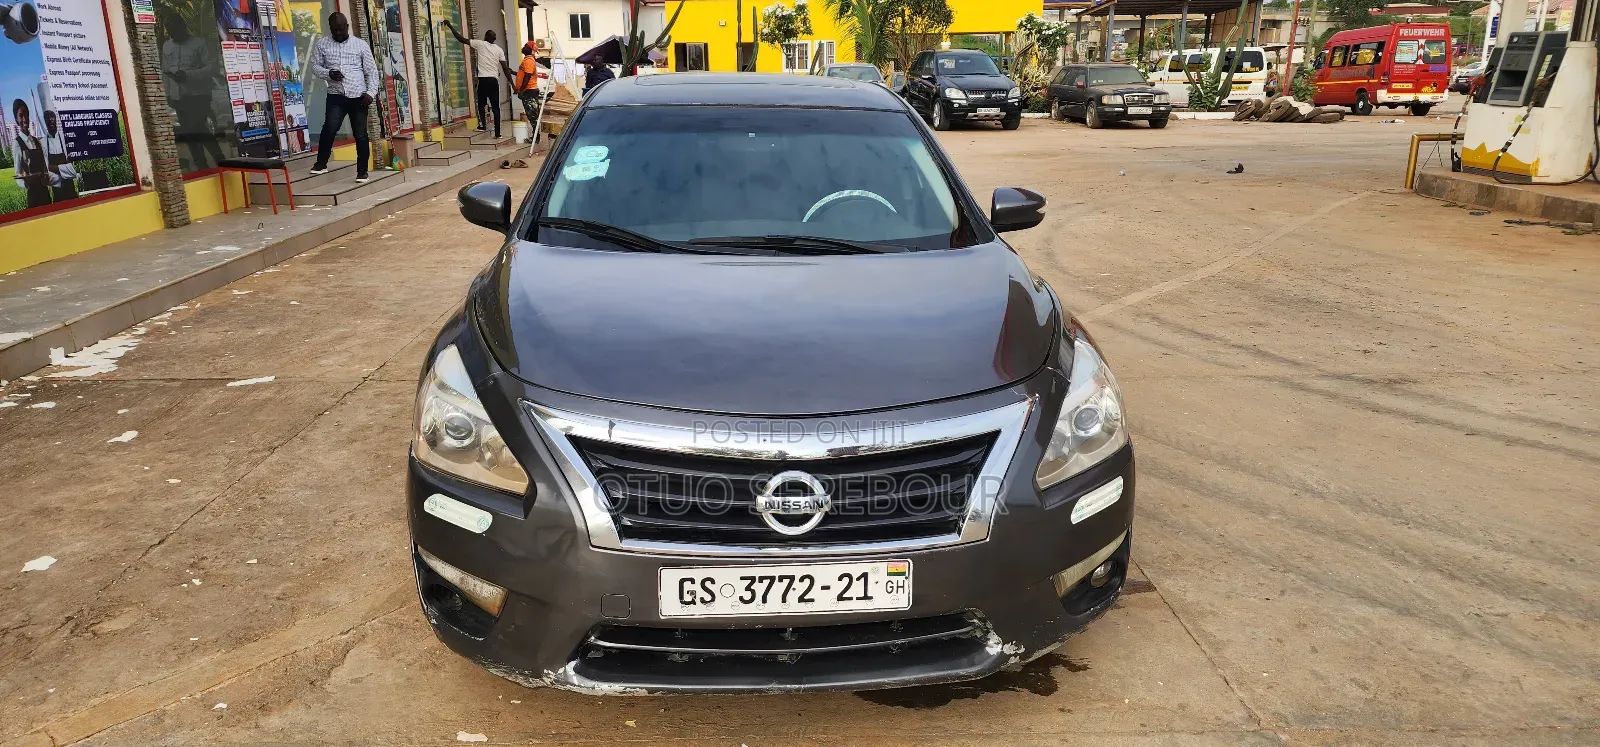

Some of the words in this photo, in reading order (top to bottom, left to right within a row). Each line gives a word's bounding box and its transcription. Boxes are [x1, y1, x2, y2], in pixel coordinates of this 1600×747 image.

[1399, 28, 1445, 36] FEUERWEHR
[764, 499, 825, 511] NISSAN
[678, 576, 716, 606] GS
[738, 571, 874, 605] 3772-21
[885, 579, 906, 595] GH
